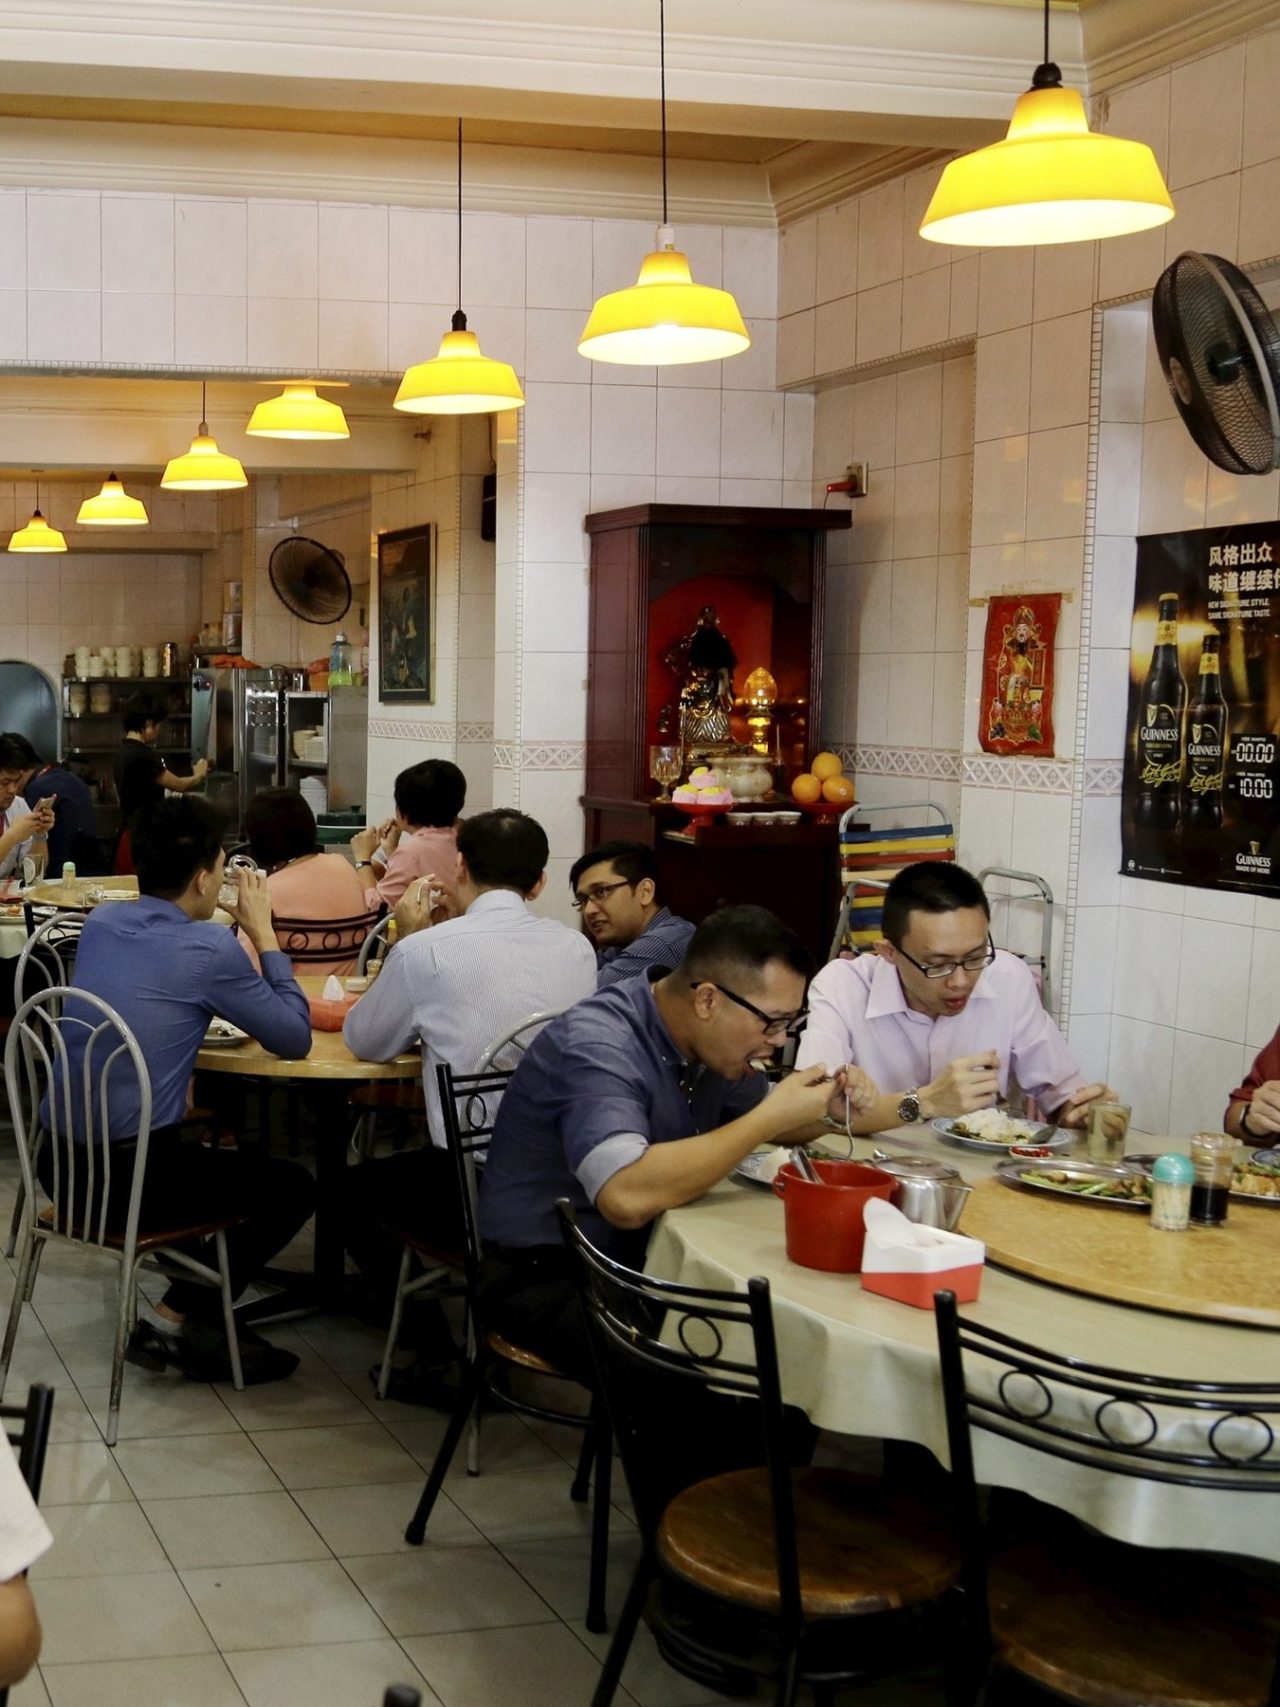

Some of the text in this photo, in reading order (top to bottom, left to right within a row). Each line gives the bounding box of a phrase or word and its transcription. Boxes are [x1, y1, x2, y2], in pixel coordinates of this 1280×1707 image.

[1209, 542, 1272, 566] 风格出众
[1140, 727, 1179, 742] GUINNESS
[1188, 743, 1222, 756] GUINNESS
[1236, 743, 1274, 763] 00.00
[1240, 777, 1273, 799] 10.00
[1236, 853, 1271, 866] GUINNESS
